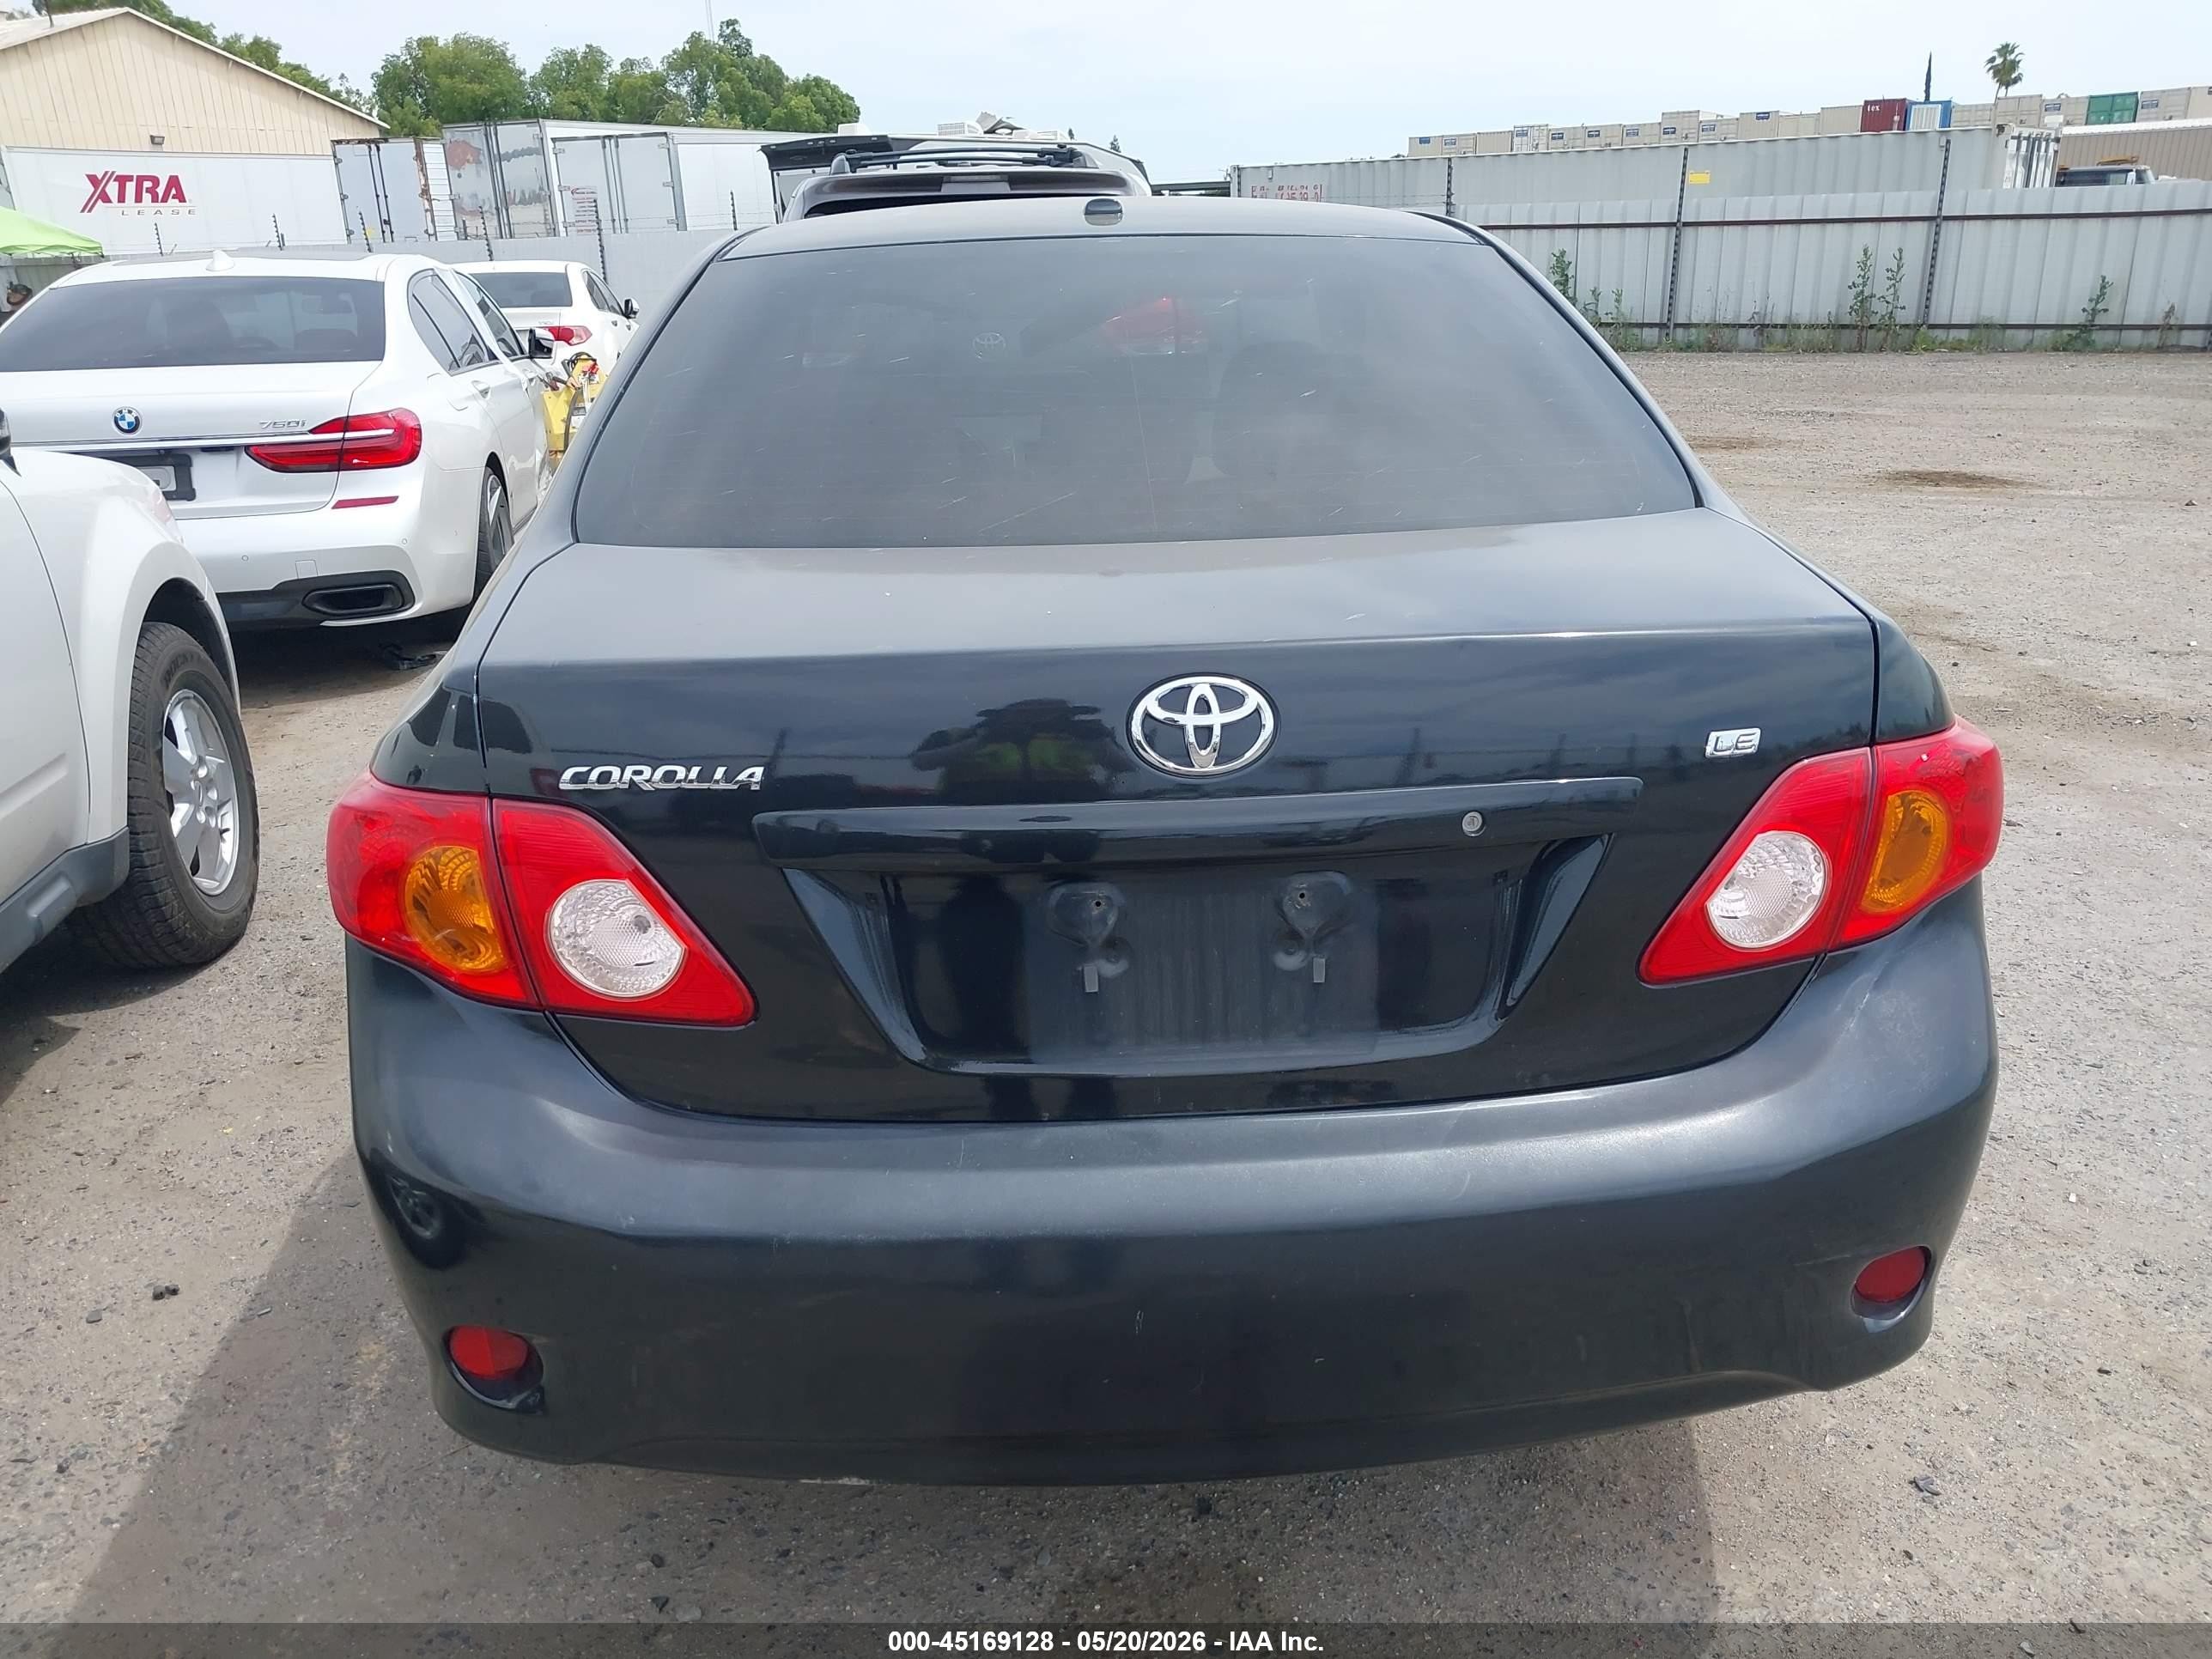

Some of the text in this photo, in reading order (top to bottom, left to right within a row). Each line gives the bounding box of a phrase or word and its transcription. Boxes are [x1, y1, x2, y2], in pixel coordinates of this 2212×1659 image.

[80, 171, 187, 213] XTRA
[259, 418, 307, 429] 750i
[1709, 730, 1759, 754] LE
[558, 764, 764, 791] COROLLA
